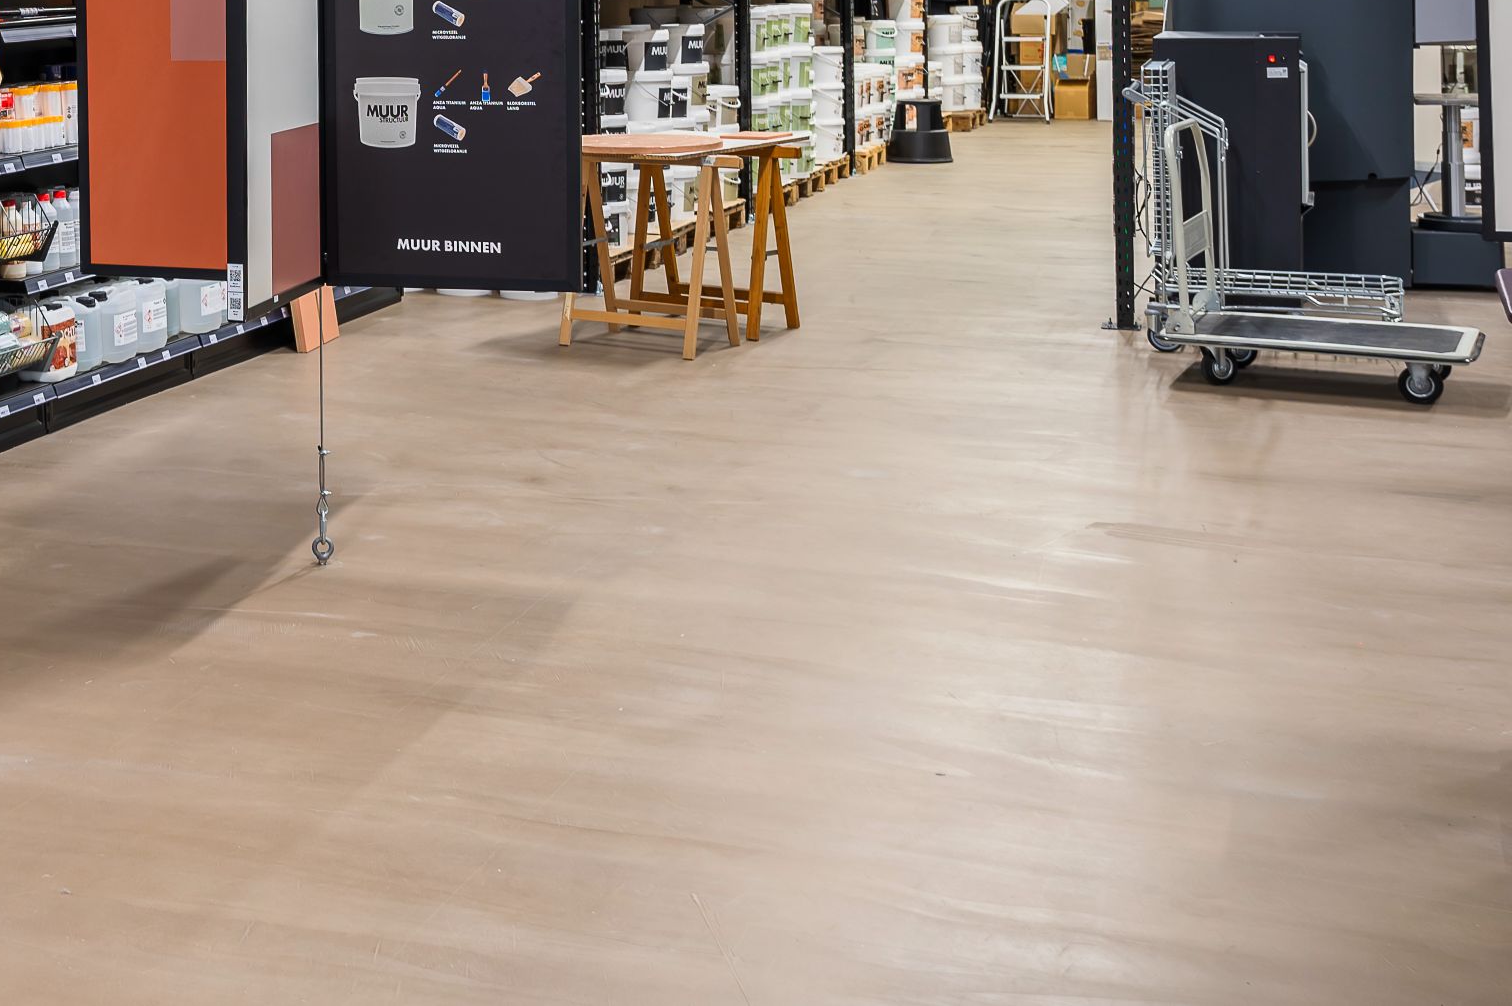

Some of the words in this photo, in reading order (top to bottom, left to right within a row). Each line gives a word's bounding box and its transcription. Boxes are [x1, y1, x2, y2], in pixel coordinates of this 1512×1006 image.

[367, 104, 408, 118] MUUR
[379, 115, 408, 123] STRUCTUUR
[397, 238, 441, 252] MUUR
[445, 240, 501, 254] BINNEN
